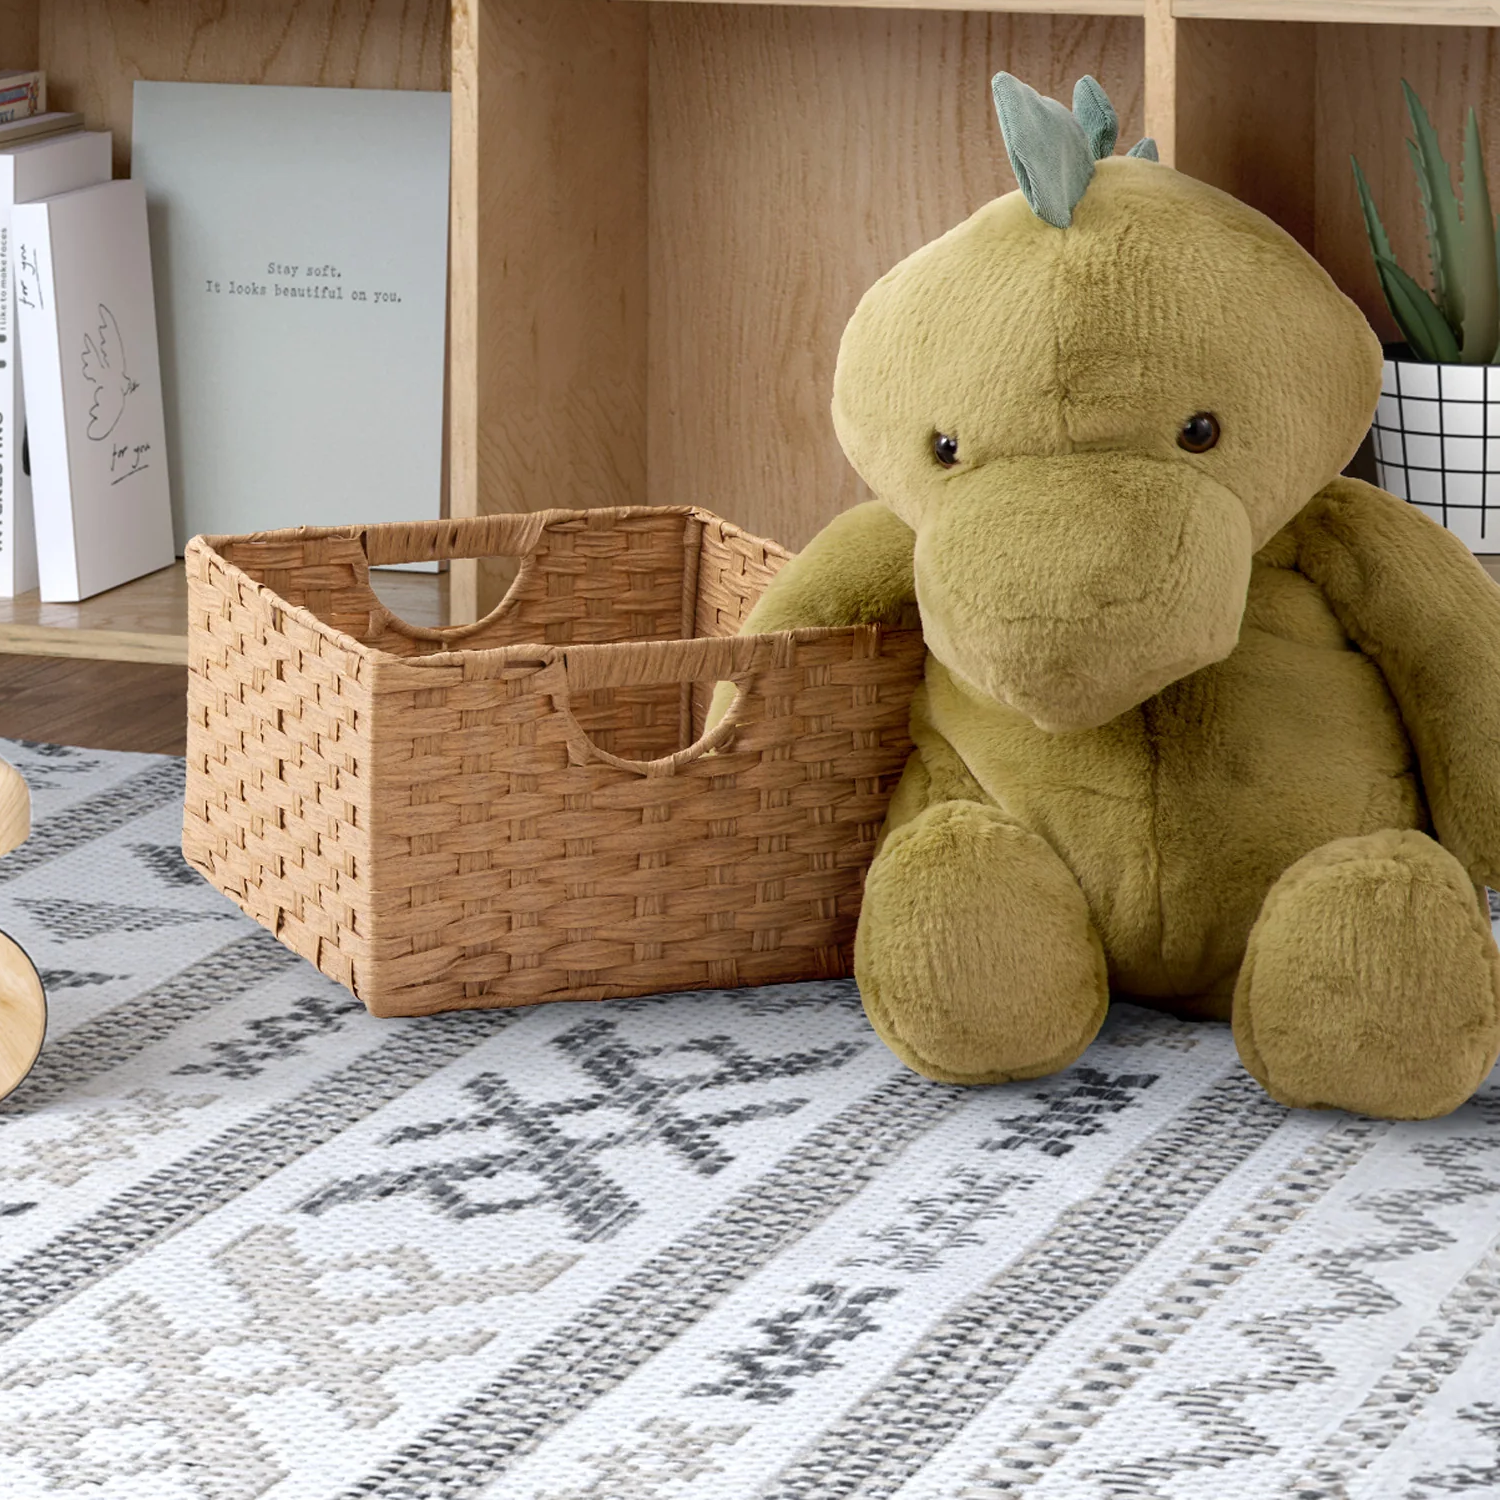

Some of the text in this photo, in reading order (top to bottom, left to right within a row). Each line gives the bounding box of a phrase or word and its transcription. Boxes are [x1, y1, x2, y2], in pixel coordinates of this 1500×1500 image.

[0, 227, 7, 258] faces
[0, 260, 7, 289] make
[267, 262, 342, 278] Stay soft.
[0, 290, 7, 302] to
[205, 280, 402, 304] It looks beautiful on you.
[0, 305, 7, 325] like
